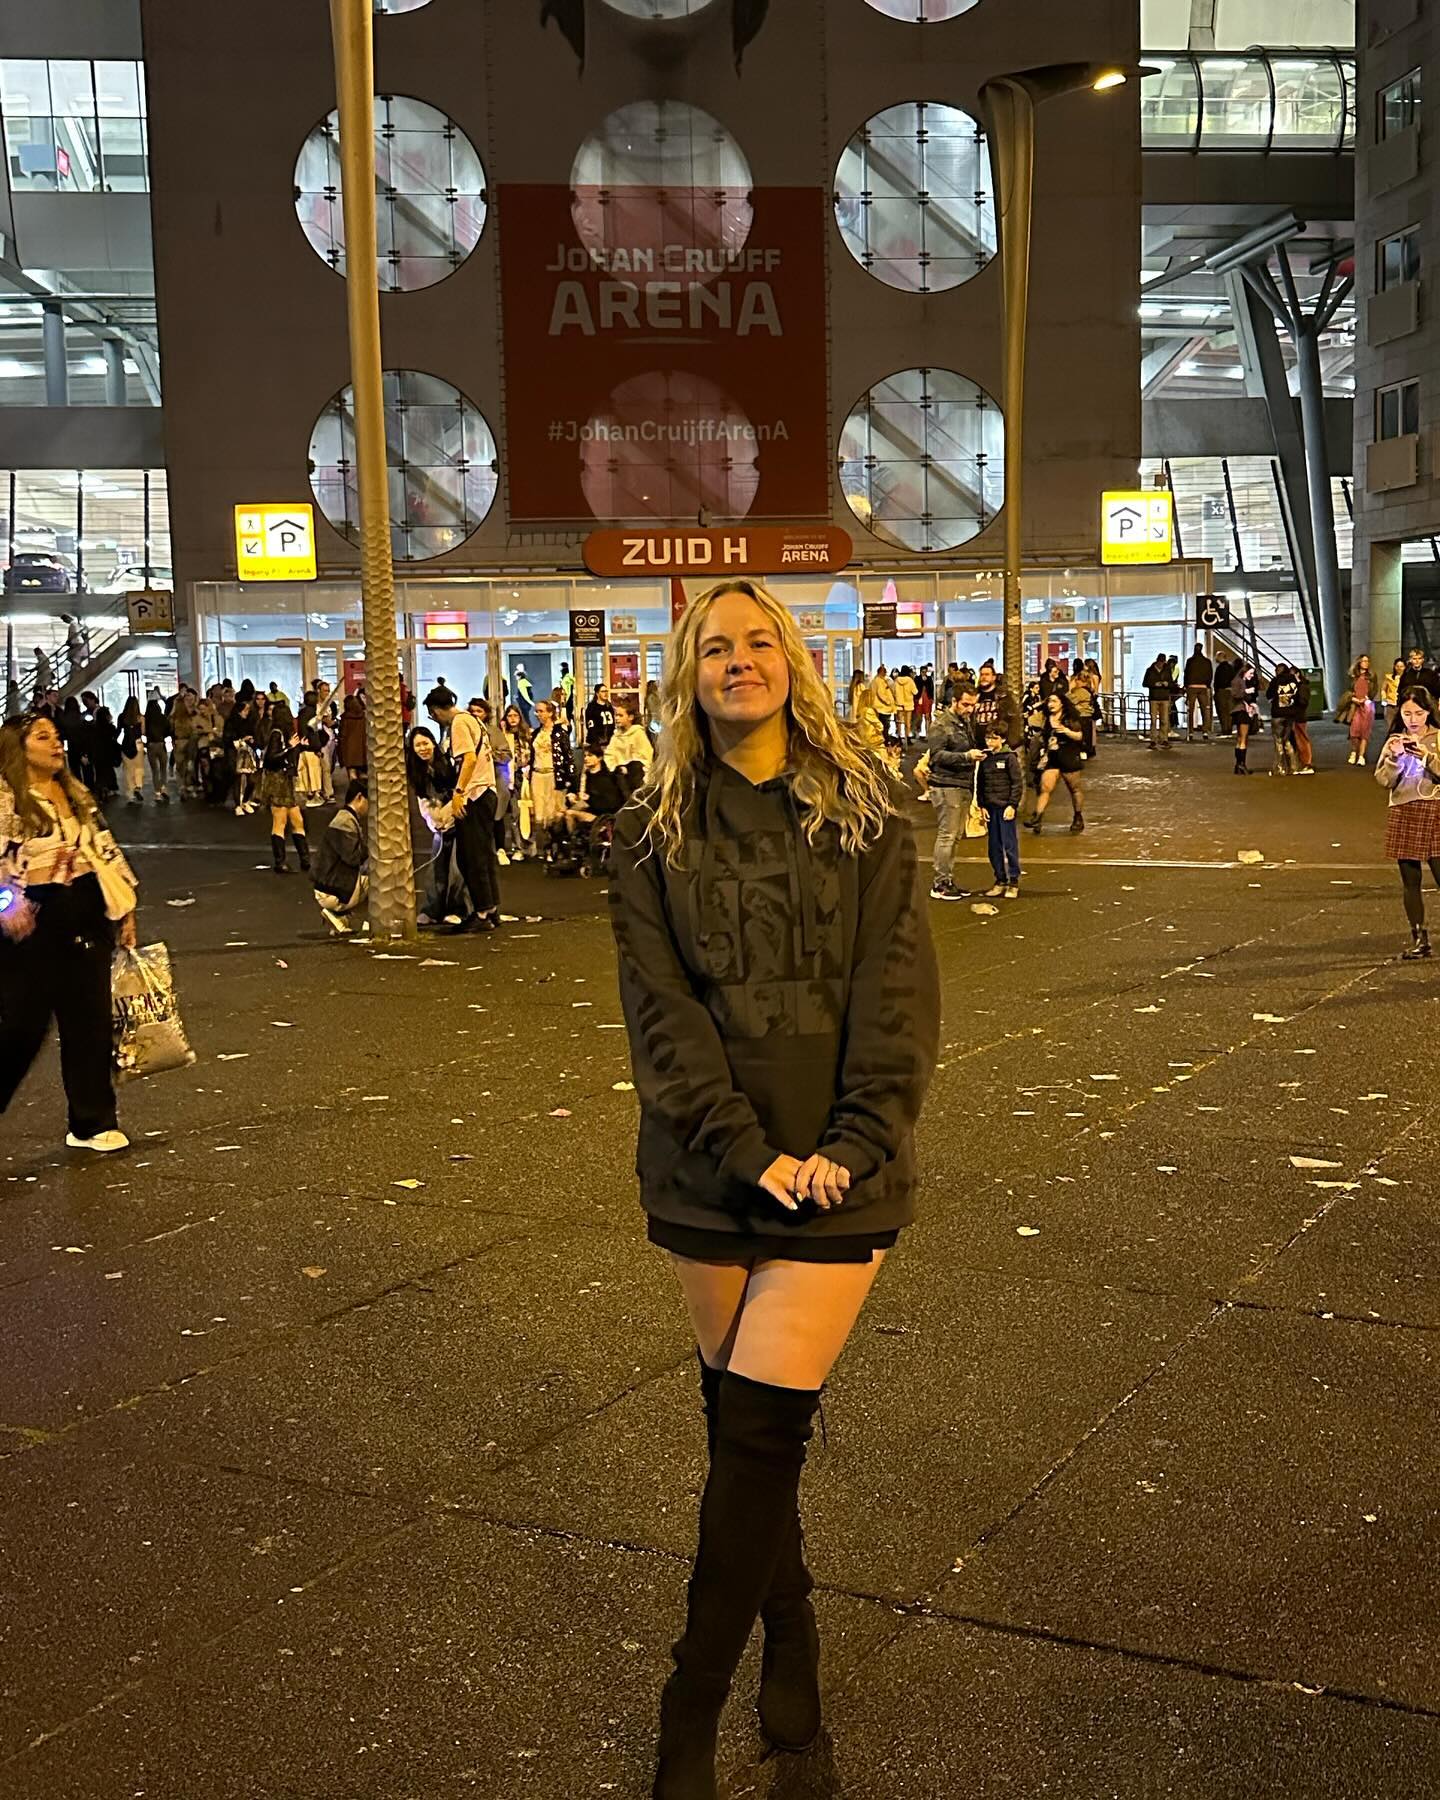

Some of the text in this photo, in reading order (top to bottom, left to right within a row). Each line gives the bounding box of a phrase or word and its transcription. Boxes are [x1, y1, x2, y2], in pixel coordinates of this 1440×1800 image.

[546, 243, 654, 272] JOHAN
[548, 280, 784, 336] ARENA
[548, 419, 789, 447] #JohanCruijffArenA
[622, 537, 748, 565] ZUID H
[781, 550, 829, 563] ARENA
[600, 711, 614, 725] 13
